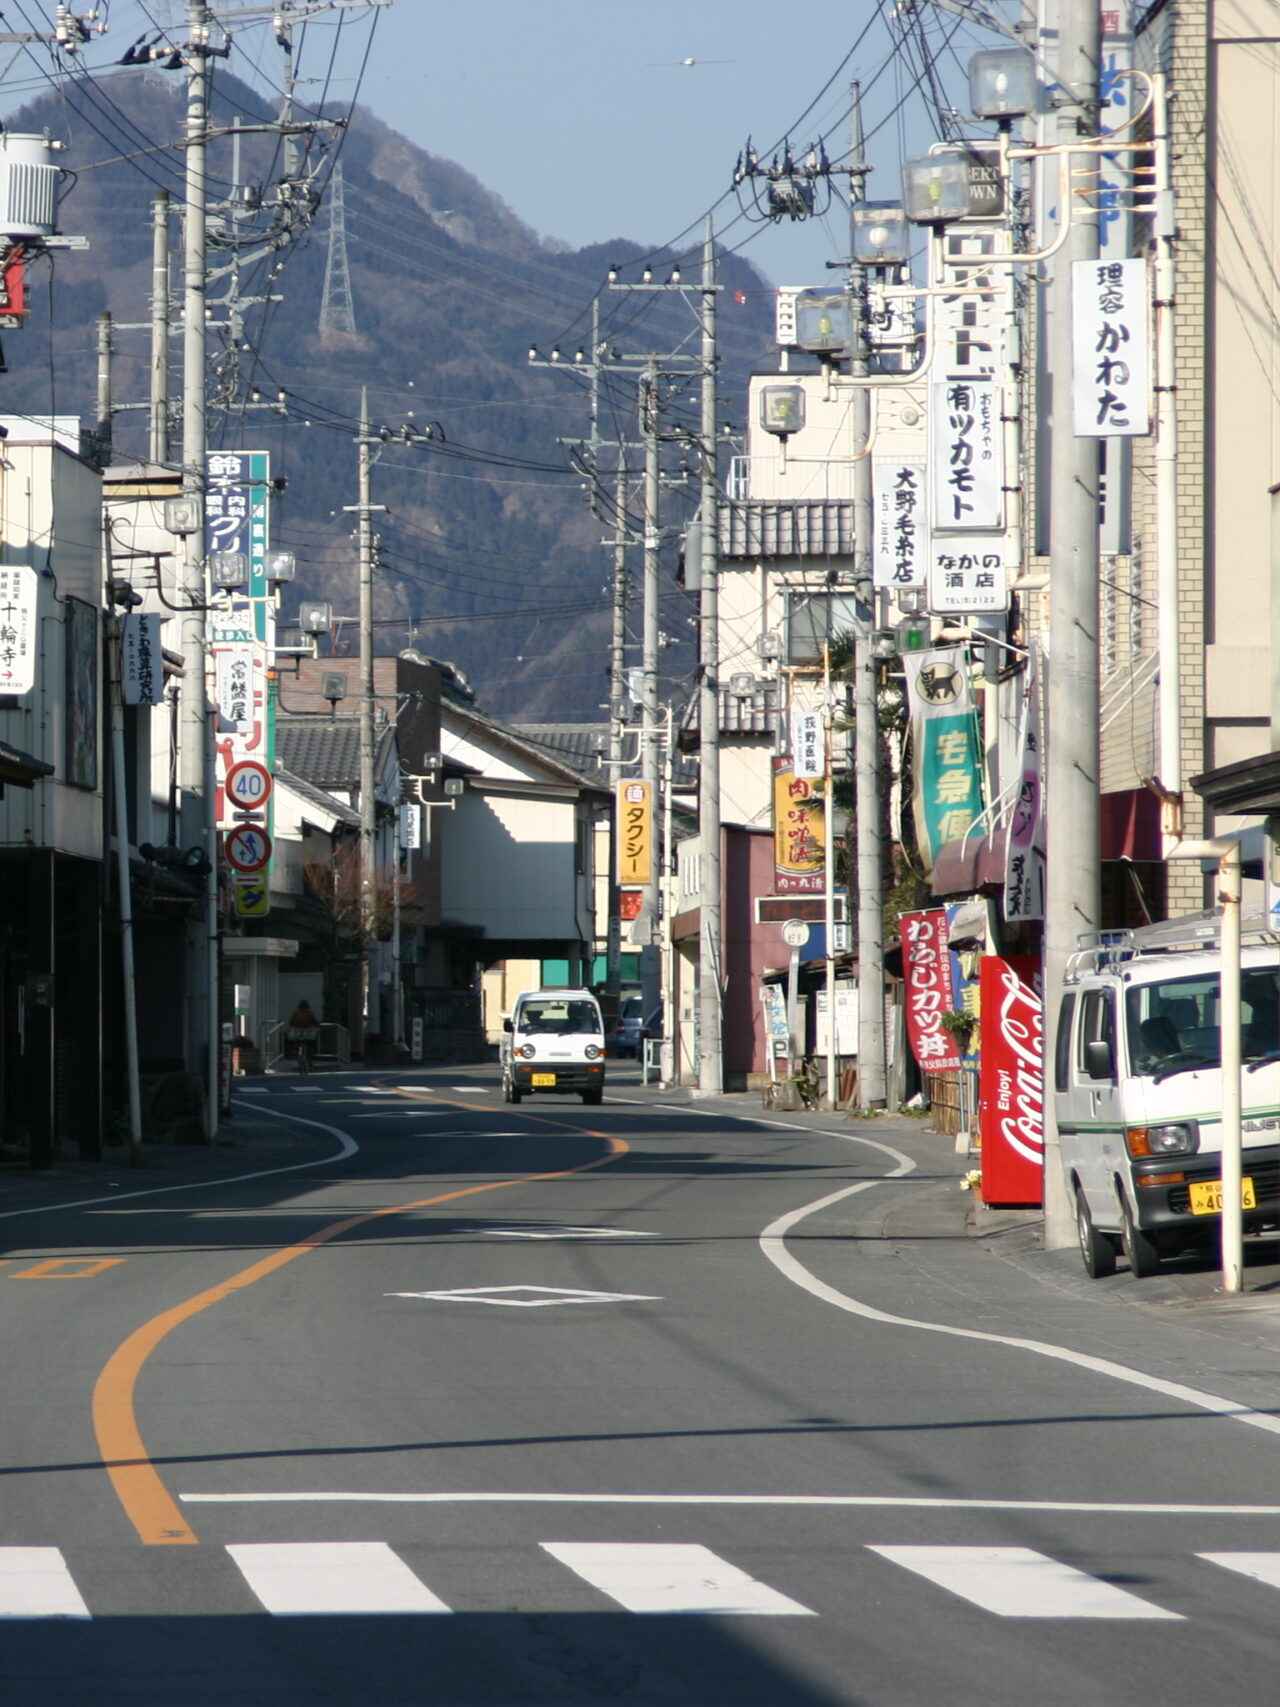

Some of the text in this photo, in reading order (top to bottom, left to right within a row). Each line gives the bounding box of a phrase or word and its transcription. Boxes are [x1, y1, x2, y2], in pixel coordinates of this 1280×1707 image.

[942, 234, 996, 381] ロバート
[980, 392, 993, 461] おもちゃの
[892, 467, 919, 583] 大野毛糸店
[936, 553, 1001, 571] なかの
[0, 601, 18, 668] 十輪寺
[230, 660, 247, 722] 常盤屋
[235, 774, 261, 796] 40
[934, 730, 973, 845] 宅急便
[626, 807, 645, 873] タクシー
[907, 920, 949, 1058] わらじカツ丼
[997, 1069, 1012, 1111] Enjoy!
[1001, 960, 1043, 1166] Coca-Cl
